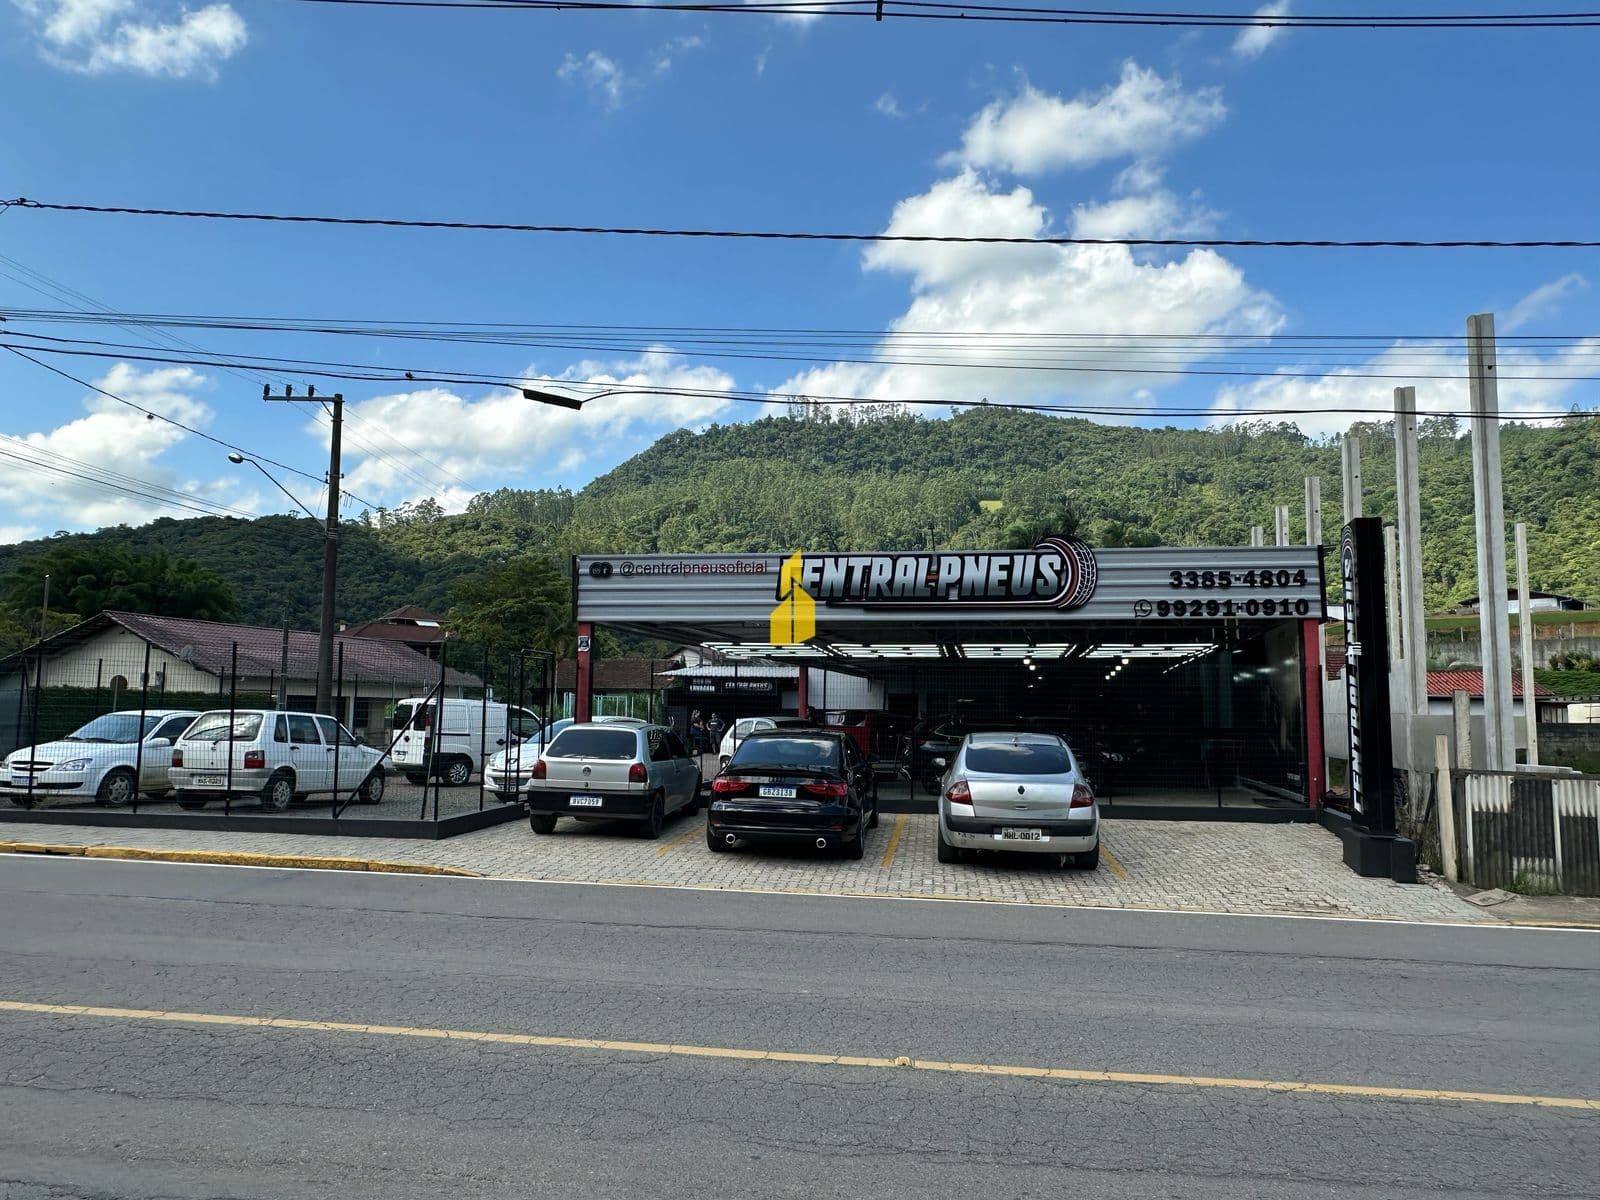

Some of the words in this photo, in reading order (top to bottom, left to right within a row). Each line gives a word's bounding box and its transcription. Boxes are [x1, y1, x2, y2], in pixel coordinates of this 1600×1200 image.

[619, 560, 767, 576] @centralpneusoficial
[1168, 570, 1308, 589] 3385-4804
[1156, 598, 1310, 617] 99291-0910
